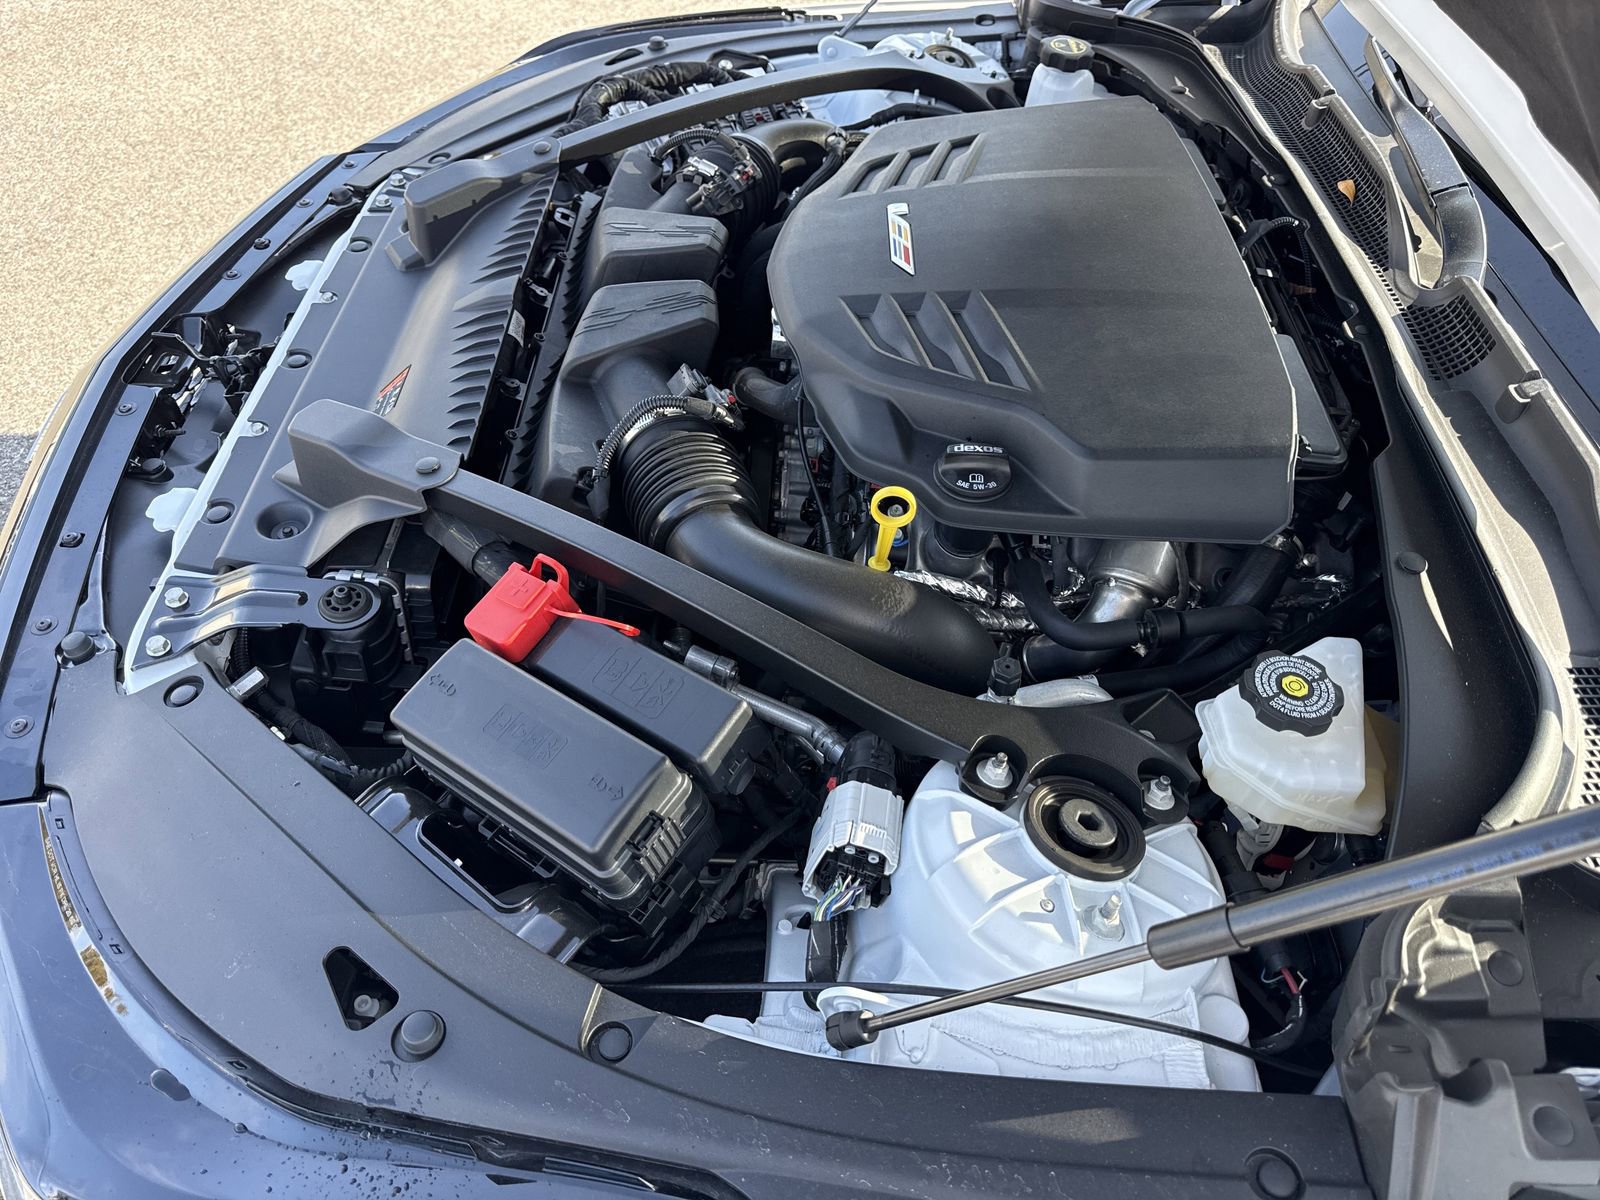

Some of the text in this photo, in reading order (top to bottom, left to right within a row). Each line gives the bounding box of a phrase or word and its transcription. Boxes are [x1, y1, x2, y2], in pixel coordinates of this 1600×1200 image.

[953, 443, 1004, 453] dexos
[956, 479, 997, 490] SAE 5W-30
[1269, 701, 1281, 709] DOT
[1284, 709, 1301, 718] FLUID
